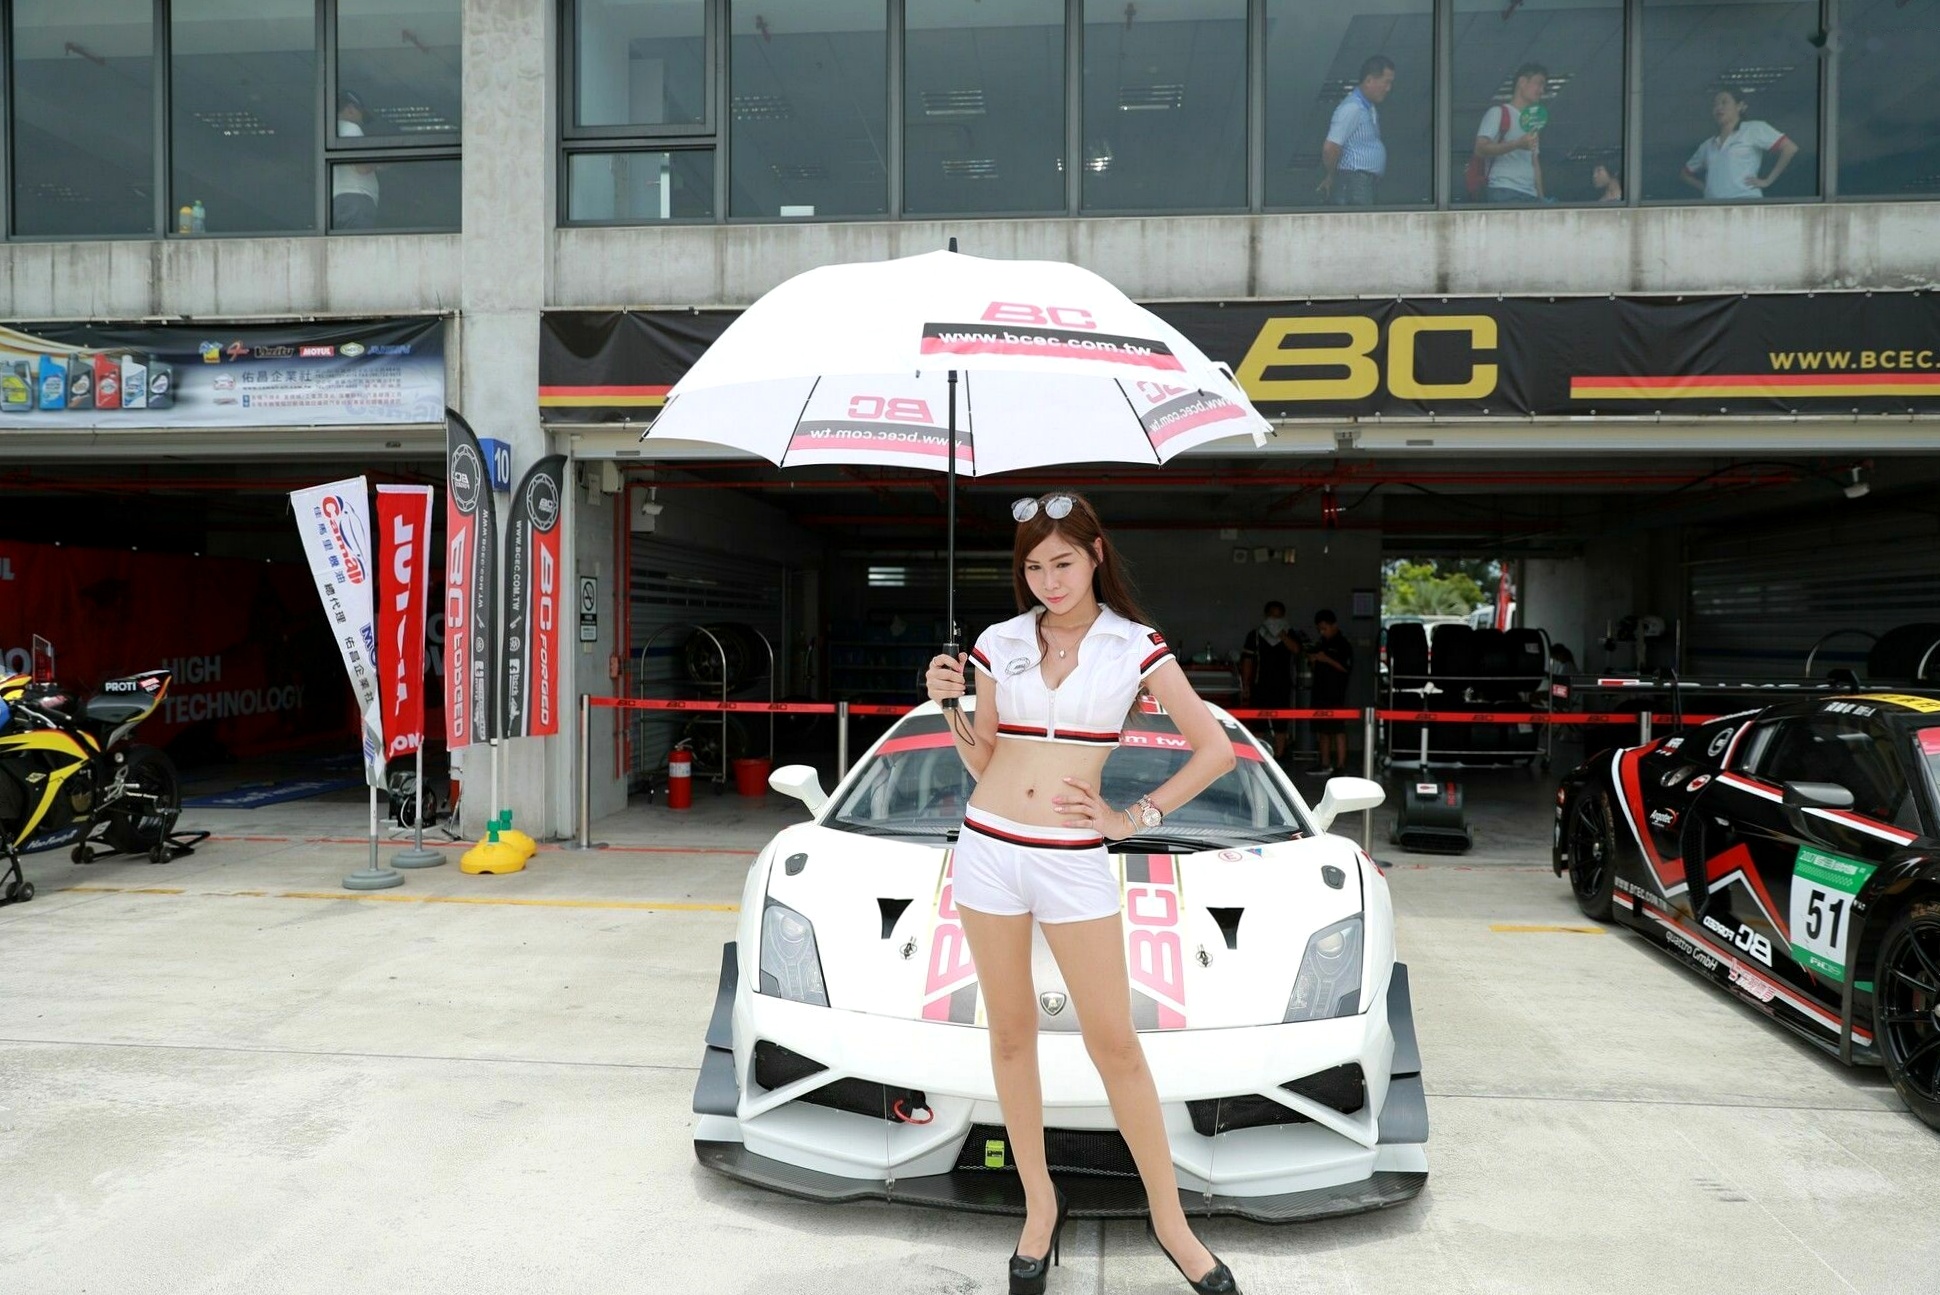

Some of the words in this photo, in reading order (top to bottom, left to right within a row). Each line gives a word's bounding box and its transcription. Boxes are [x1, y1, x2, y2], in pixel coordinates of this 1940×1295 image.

[980, 302, 1097, 329] BC
[302, 346, 331, 356] MOTUL
[938, 331, 1151, 357] www.bcec.com.tw
[1234, 315, 1498, 400] BC
[494, 447, 509, 484] 10
[512, 520, 523, 611] WWW.BCEC.COM.TW
[539, 541, 554, 631] BC
[105, 681, 136, 692] PROTI
[162, 655, 222, 684] HIGH
[539, 633, 549, 727] FORGED
[163, 685, 305, 724] TECHNOLOGY
[1806, 889, 1844, 949] 51
[1127, 888, 1186, 1007] BC
[1665, 930, 1693, 956] quattro
[1692, 945, 1719, 972] GmbH
